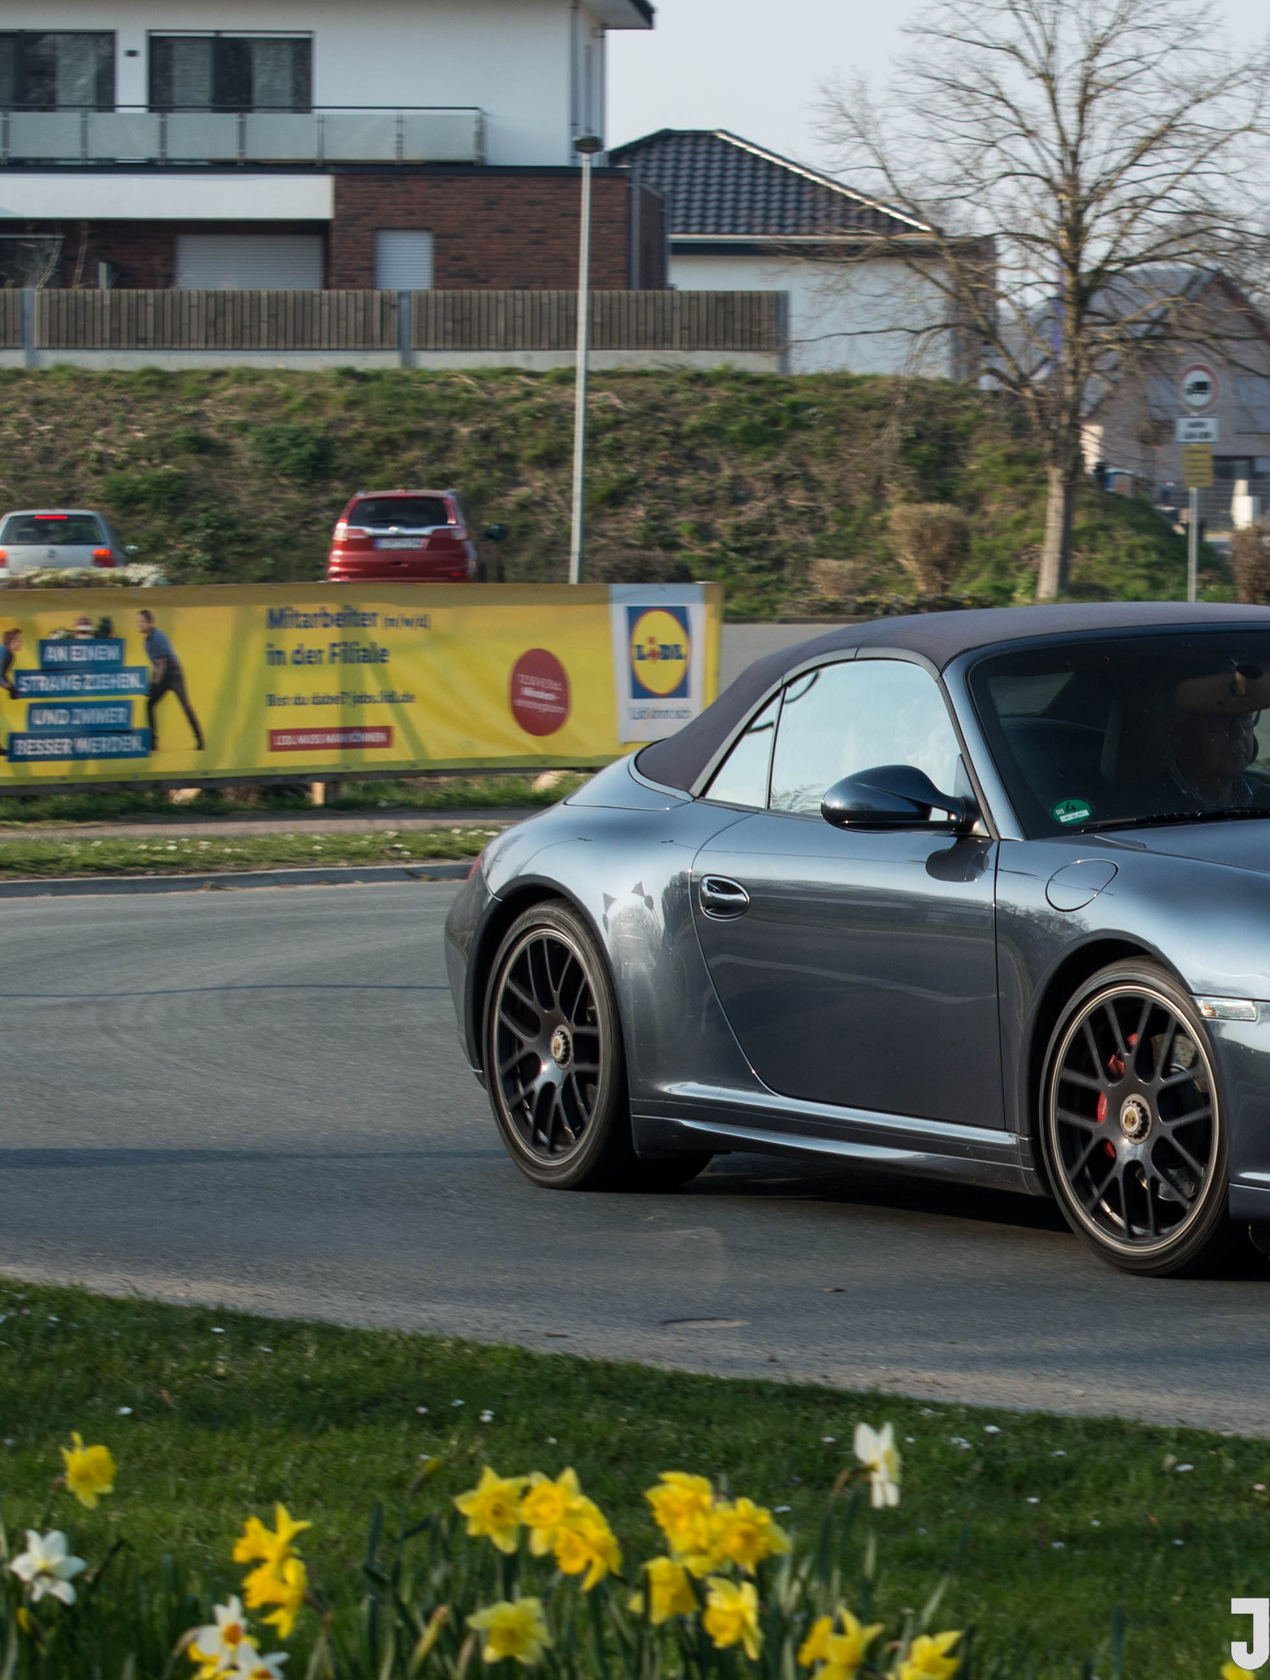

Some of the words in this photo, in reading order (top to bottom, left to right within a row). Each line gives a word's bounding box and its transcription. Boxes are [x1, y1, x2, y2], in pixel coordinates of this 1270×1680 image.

[266, 605, 379, 629] Mitarbeiter
[43, 646, 68, 662] AN
[70, 645, 120, 661] EINEM
[266, 643, 287, 666] in
[291, 643, 324, 665] der
[328, 641, 390, 664] Filiale
[18, 674, 82, 692] STRANG
[83, 672, 145, 690] ZIEHEN.
[31, 708, 70, 726] UND
[71, 707, 128, 725] IMMER
[13, 738, 73, 756] BESSER
[74, 736, 146, 754] WERDEN.
[1066, 801, 1077, 812] 4
